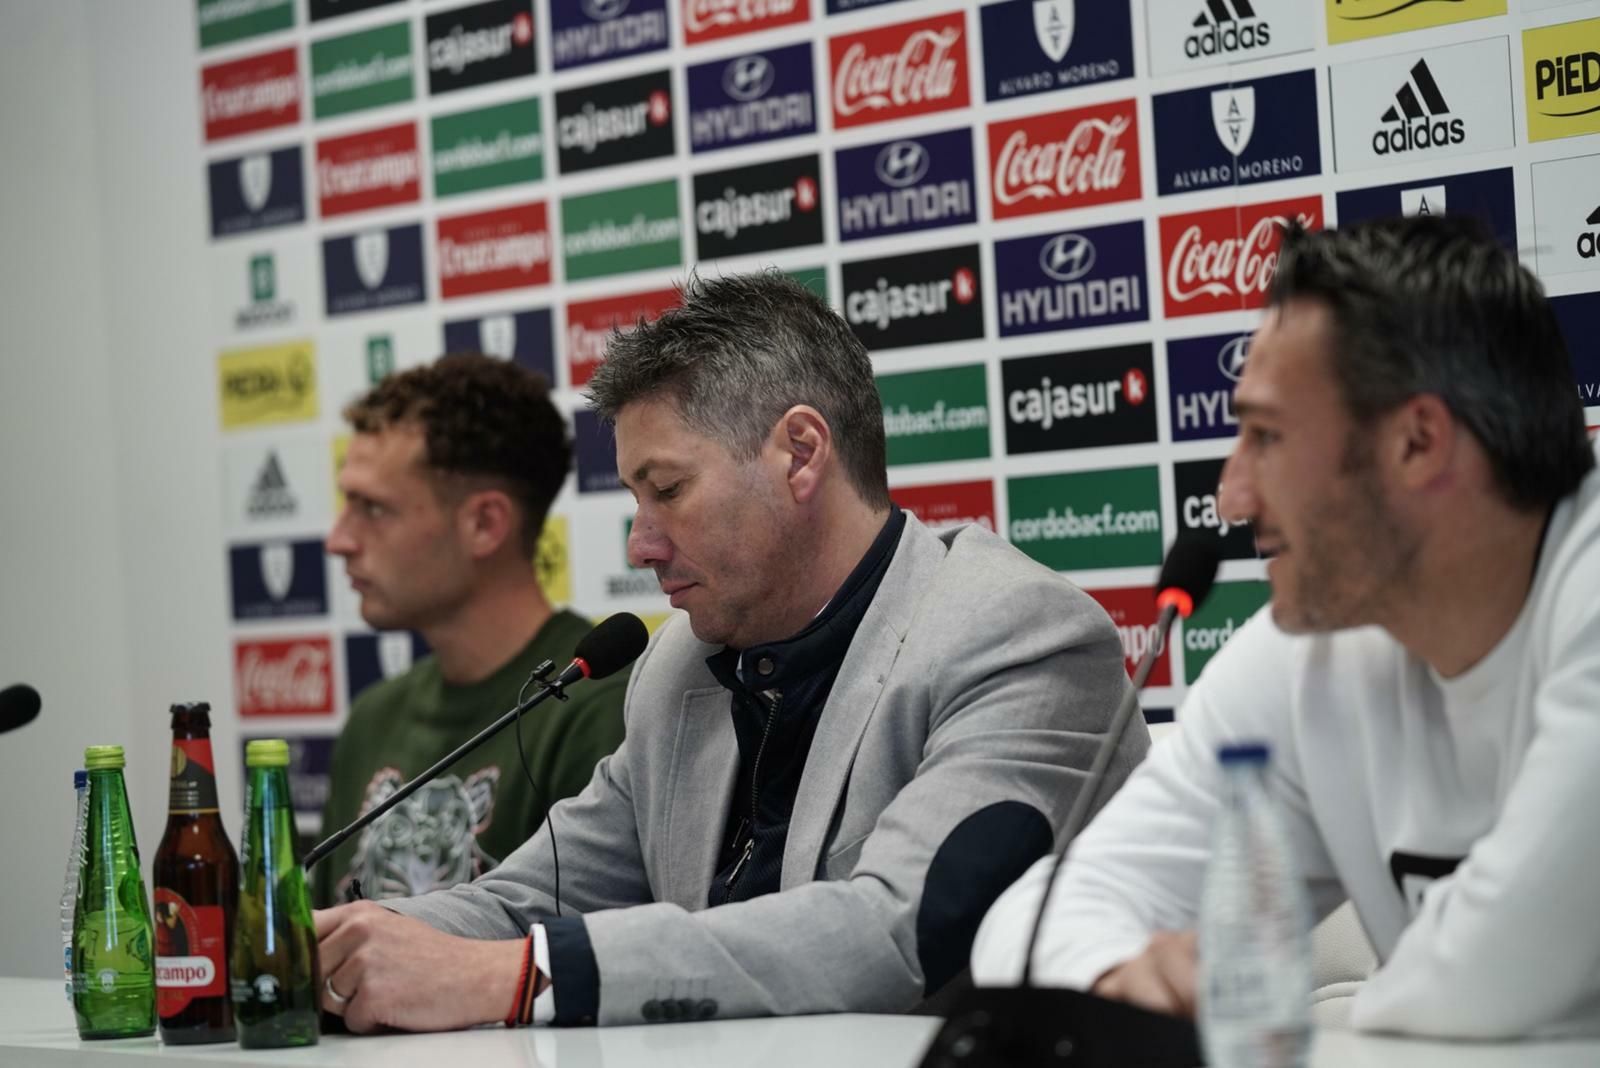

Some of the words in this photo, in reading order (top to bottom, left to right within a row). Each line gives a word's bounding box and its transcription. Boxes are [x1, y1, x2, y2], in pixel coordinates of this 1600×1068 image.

[428, 25, 513, 75] cajasur
[554, 10, 667, 64] HYUNDAI
[1185, 19, 1270, 60] adidas
[834, 27, 962, 116] Coca-Cola
[1059, 60, 1119, 83] MORENO
[558, 101, 648, 153] cajasur
[690, 92, 812, 144] HYUNDAI
[1372, 116, 1465, 156] adidas
[995, 114, 1132, 206] Coca-Cola
[1174, 164, 1231, 188] ALVARO
[1239, 155, 1303, 179] MORENO
[698, 187, 796, 239] cajasur
[842, 179, 970, 232] HYUNDAI
[1168, 212, 1315, 302] Coca-Co
[848, 277, 952, 330] cajasur
[1002, 276, 1140, 328] HYUNDAI
[1008, 377, 1121, 430] cajasur
[1010, 503, 1159, 543] cordobacf.com
